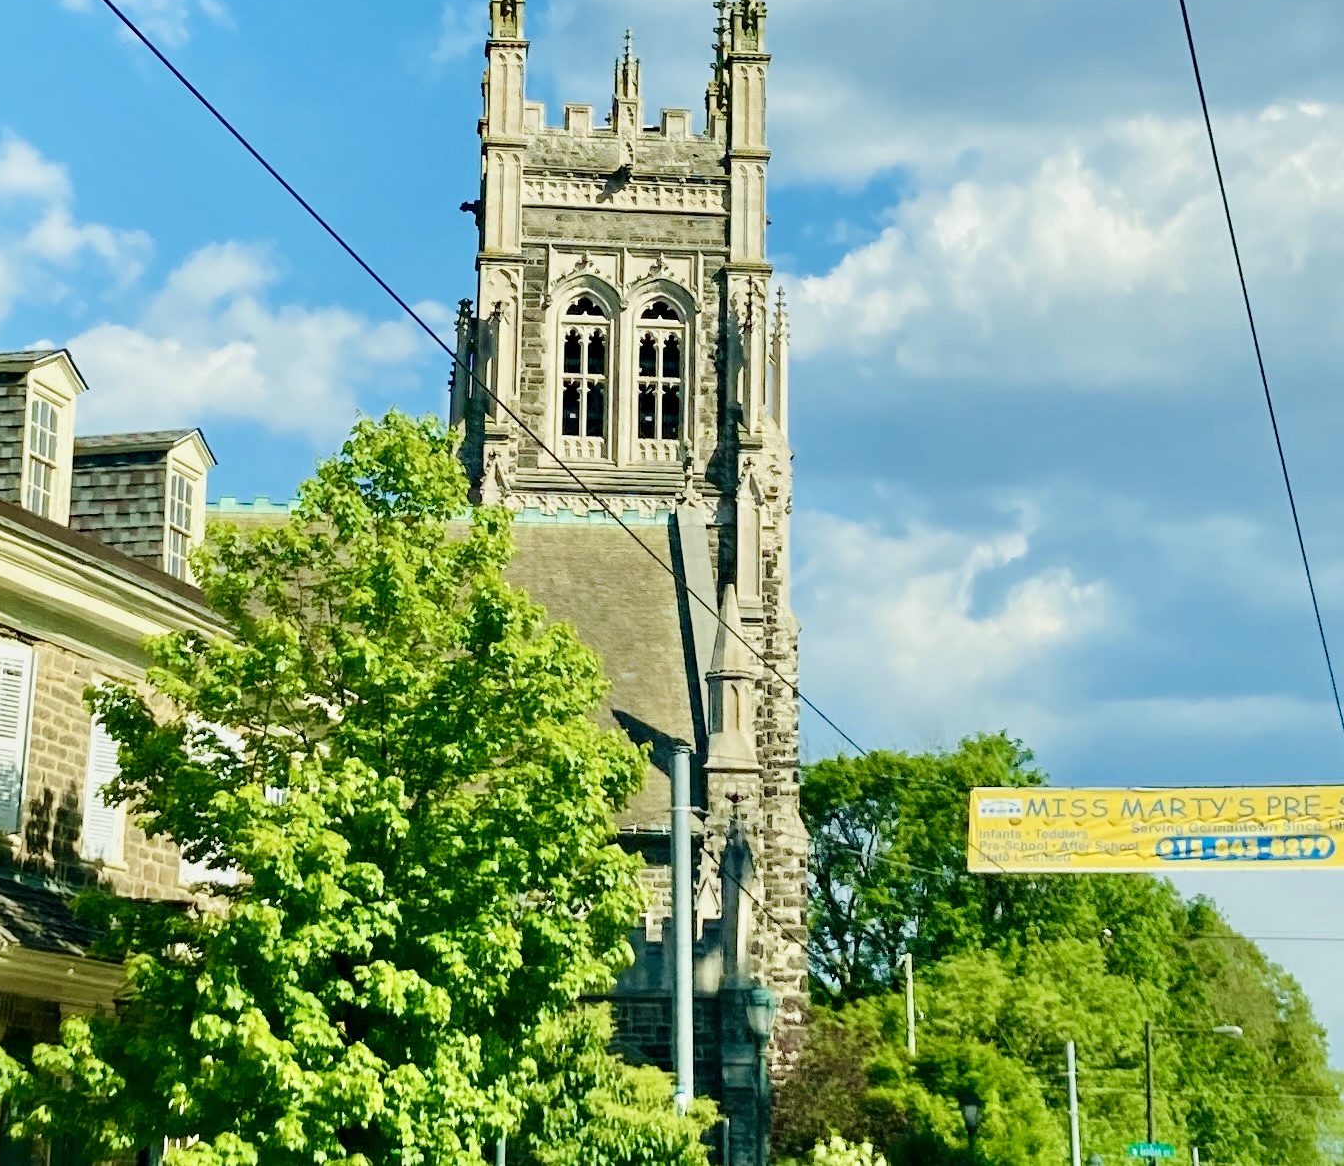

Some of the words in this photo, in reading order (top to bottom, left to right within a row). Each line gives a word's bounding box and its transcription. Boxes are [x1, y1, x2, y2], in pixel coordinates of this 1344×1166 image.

[1025, 797, 1109, 818] MISS
[1120, 796, 1256, 819] MARTY'S
[1130, 822, 1184, 835] Serving
[1188, 822, 1278, 833] Germantown
[1282, 820, 1322, 832] Since
[979, 829, 1021, 840] Infants
[1035, 829, 1089, 840] Toddlers
[979, 841, 1048, 852] Pre-School
[1060, 841, 1090, 851] After
[1095, 841, 1139, 851] School
[978, 852, 1011, 862] State
